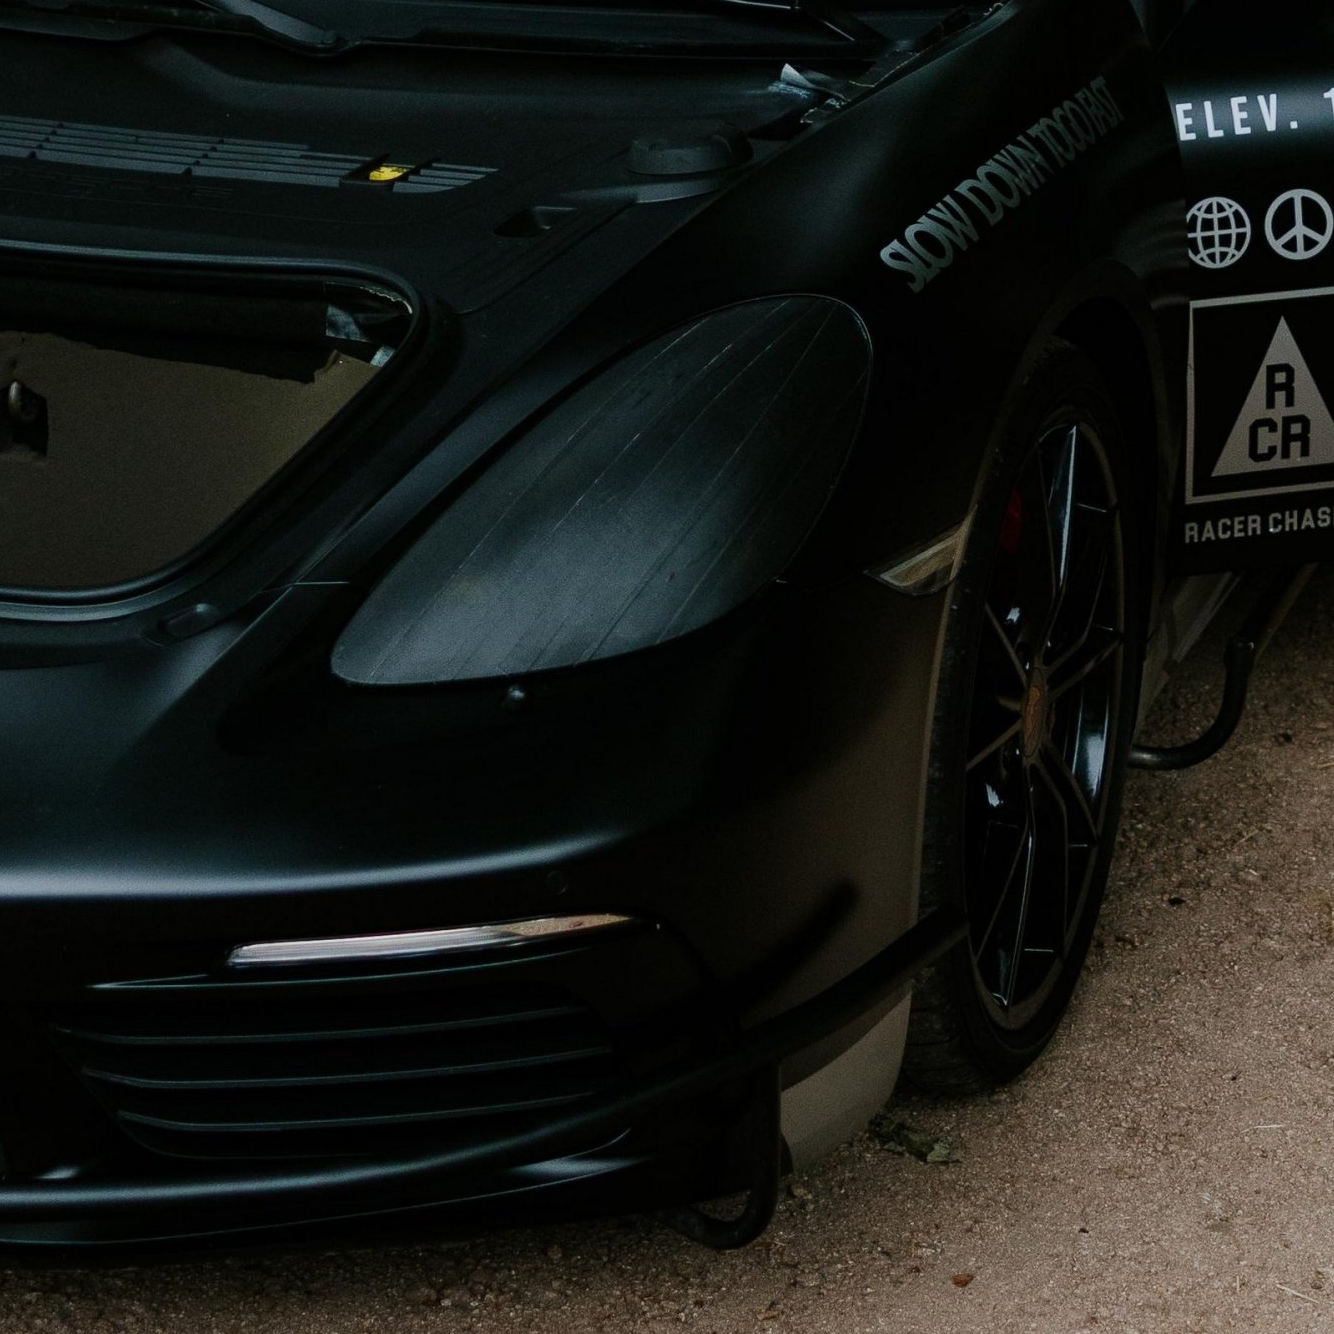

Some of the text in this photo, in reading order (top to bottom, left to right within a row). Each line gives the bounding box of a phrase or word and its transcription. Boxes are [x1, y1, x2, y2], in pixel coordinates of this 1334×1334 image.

[1175, 94, 1298, 141] ELEV.
[879, 194, 980, 294] SLOW
[954, 135, 1055, 227] DOWN
[1026, 117, 1076, 168] TO
[1052, 99, 1097, 152] GO
[1266, 362, 1296, 410] R
[1247, 414, 1312, 463] CR
[1184, 515, 1262, 544] RACER
